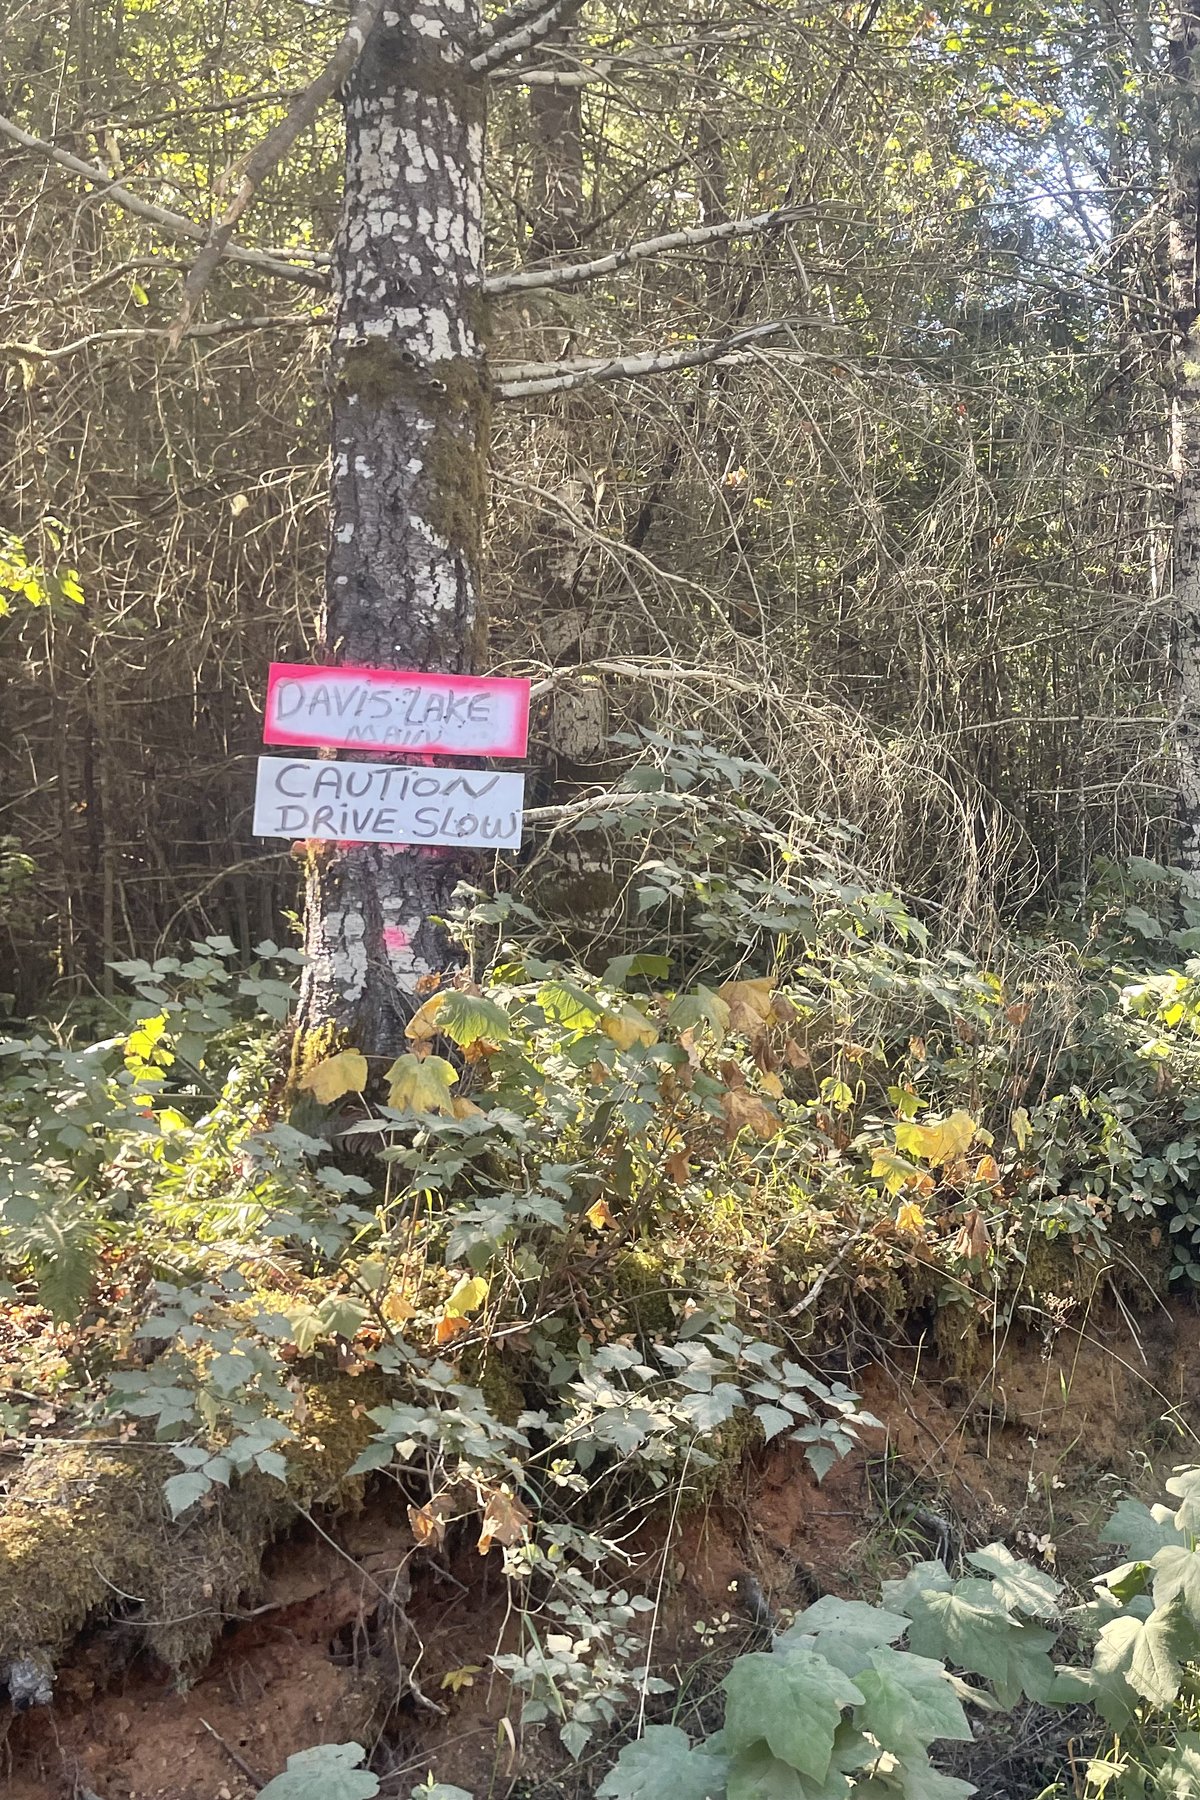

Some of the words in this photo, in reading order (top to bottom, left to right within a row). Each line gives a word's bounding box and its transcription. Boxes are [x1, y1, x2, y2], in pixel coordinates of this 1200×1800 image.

[403, 686, 491, 727] LAKE
[274, 763, 501, 801] CAUTION
[273, 802, 398, 835] DRIVE
[411, 806, 520, 839] SLOW
